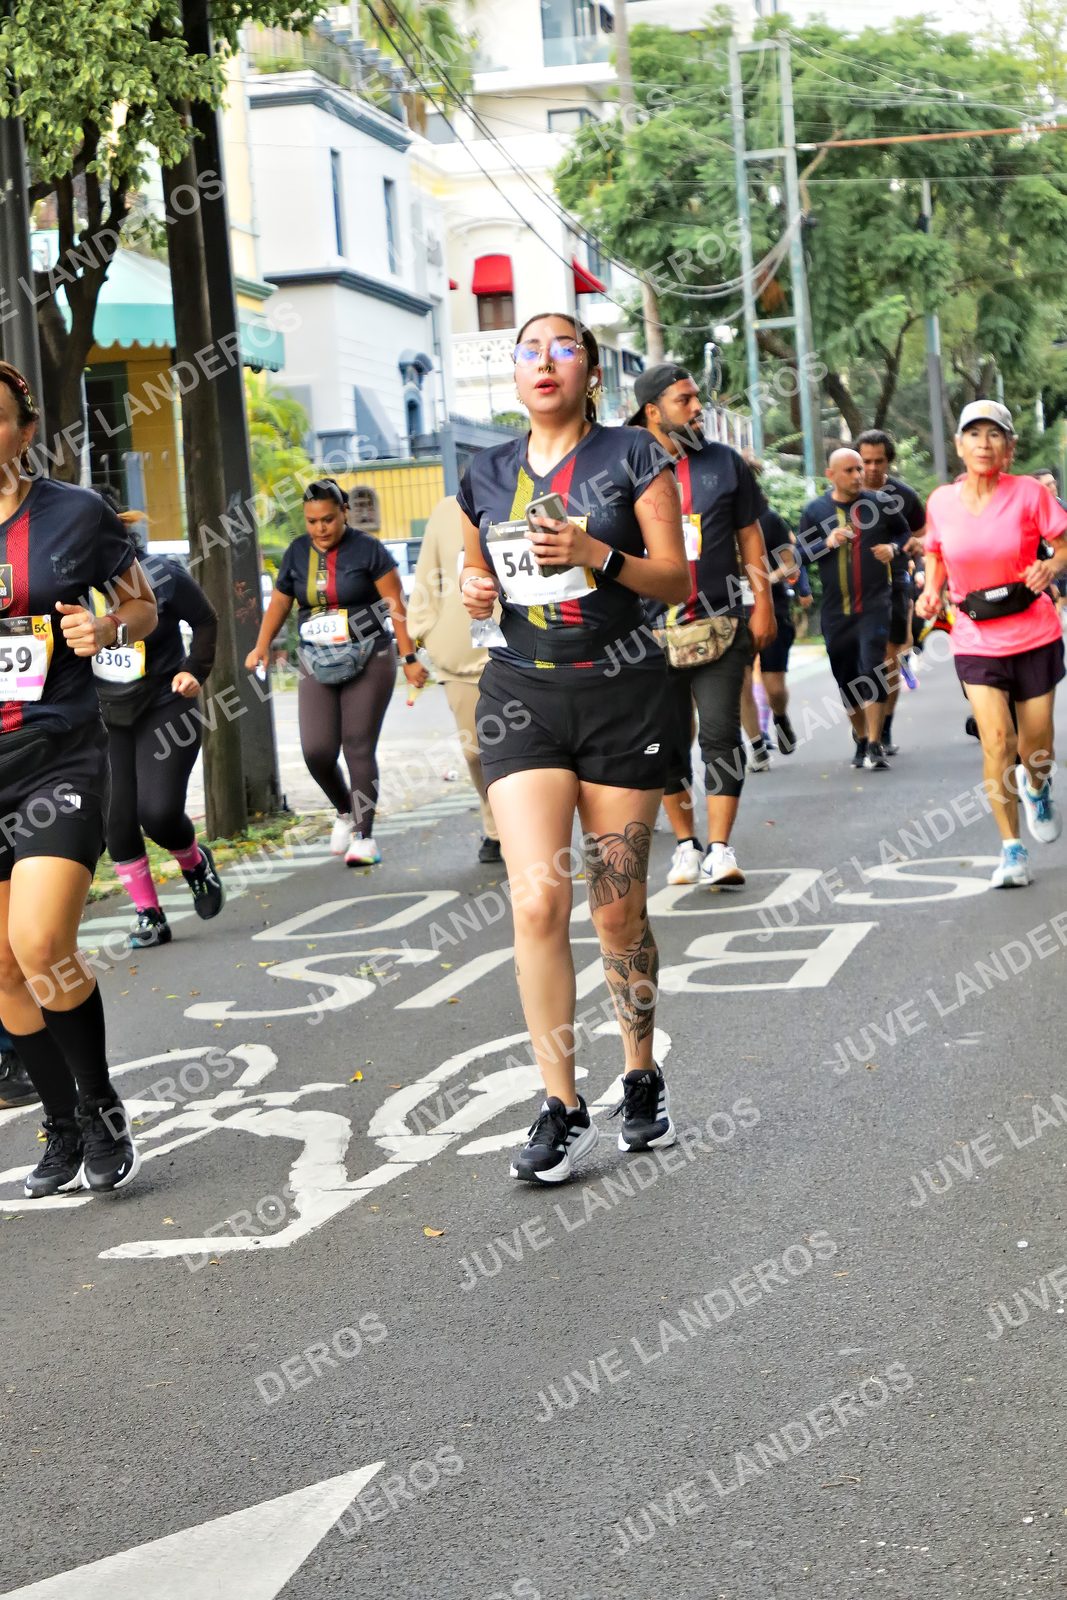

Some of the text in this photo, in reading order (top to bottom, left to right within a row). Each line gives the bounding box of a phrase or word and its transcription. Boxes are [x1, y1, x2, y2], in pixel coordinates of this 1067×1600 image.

[34, 623, 48, 634] 5K
[0, 646, 33, 673] 59
[95, 651, 132, 669] 6305
